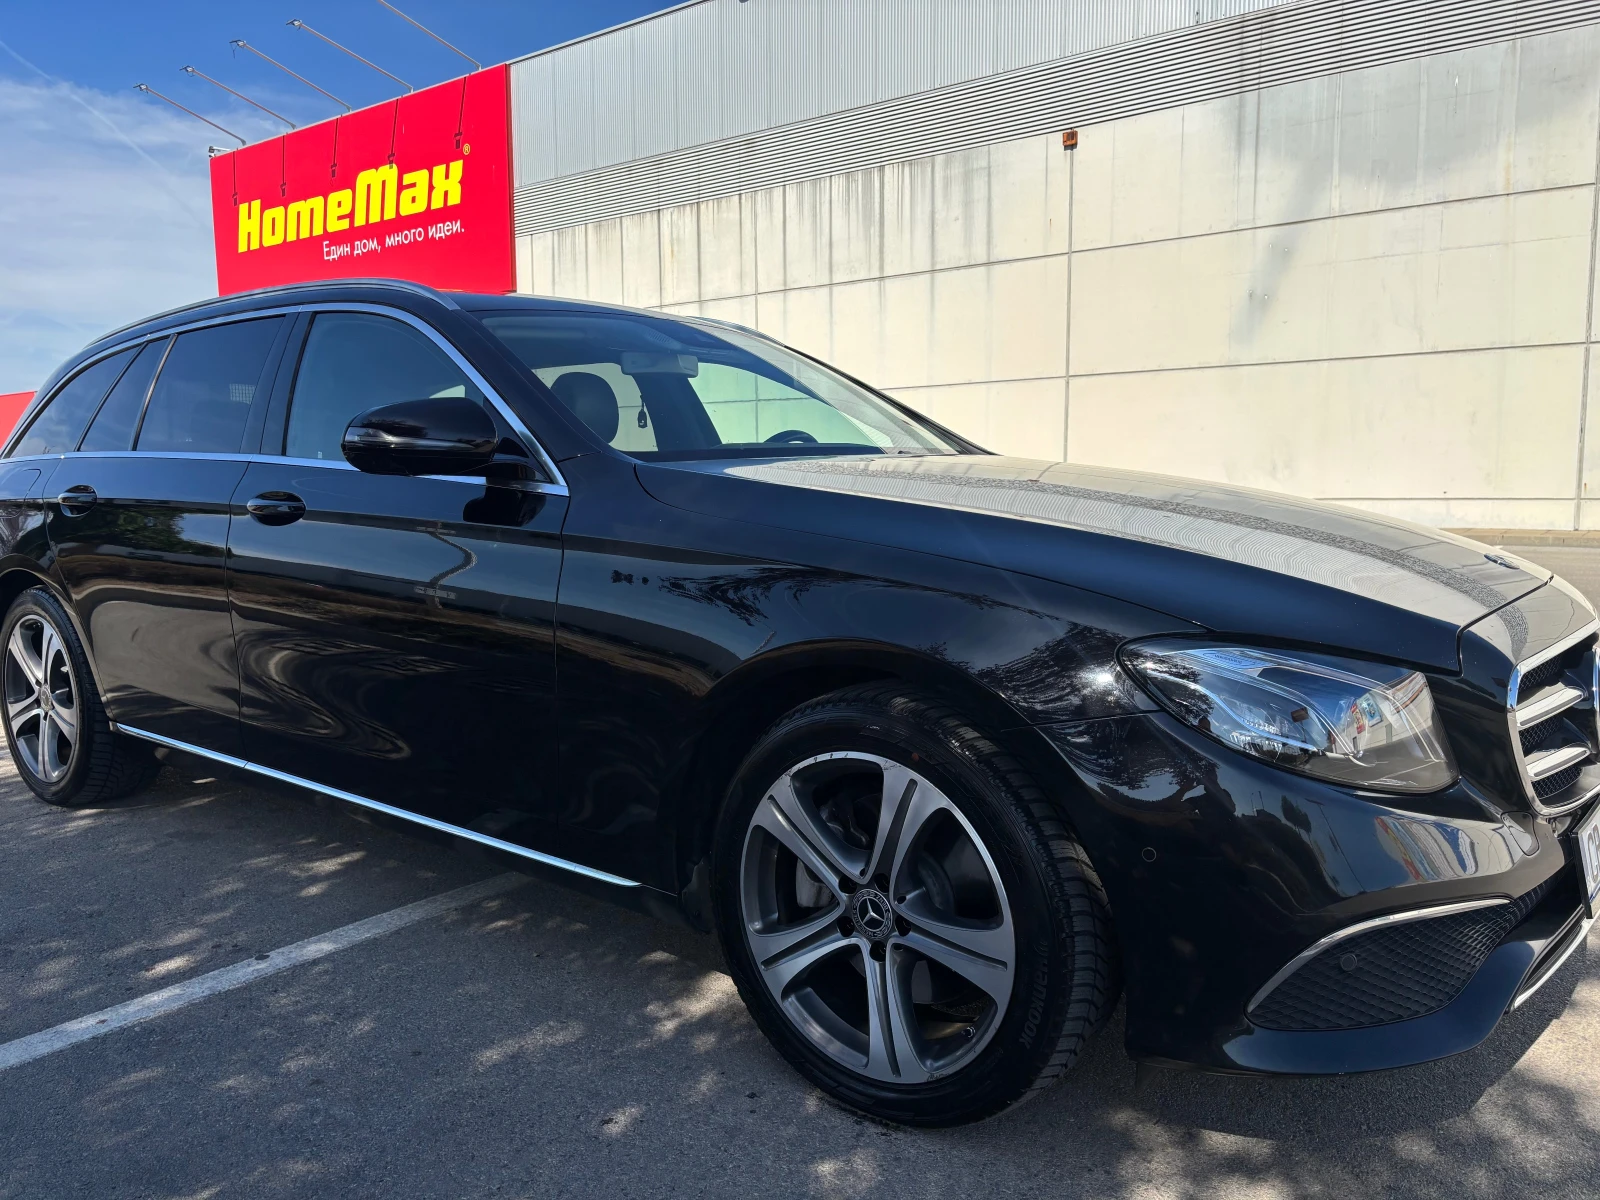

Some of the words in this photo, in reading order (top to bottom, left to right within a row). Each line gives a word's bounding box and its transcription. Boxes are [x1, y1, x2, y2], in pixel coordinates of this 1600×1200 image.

[323, 241, 351, 261] Един
[354, 237, 381, 257] дом,
[386, 228, 424, 248] много
[428, 219, 465, 239] идеи.
